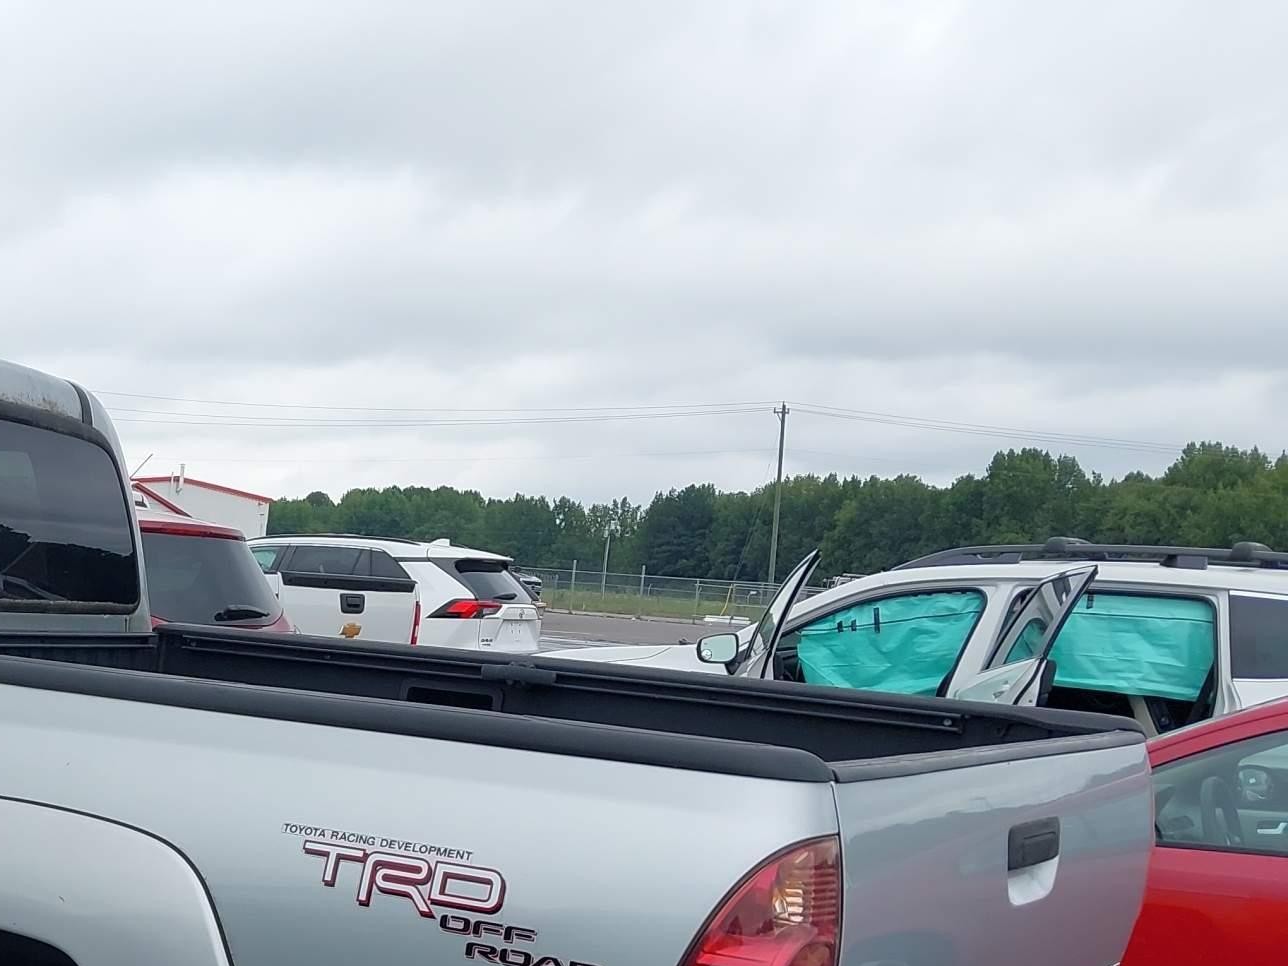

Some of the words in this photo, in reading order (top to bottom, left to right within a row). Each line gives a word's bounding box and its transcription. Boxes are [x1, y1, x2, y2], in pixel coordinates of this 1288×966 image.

[283, 823, 326, 838] TOYOTA
[330, 830, 376, 847] RACING
[380, 838, 473, 861] DEVELOPMENT
[303, 840, 506, 919] TRD
[440, 914, 538, 943] OFF
